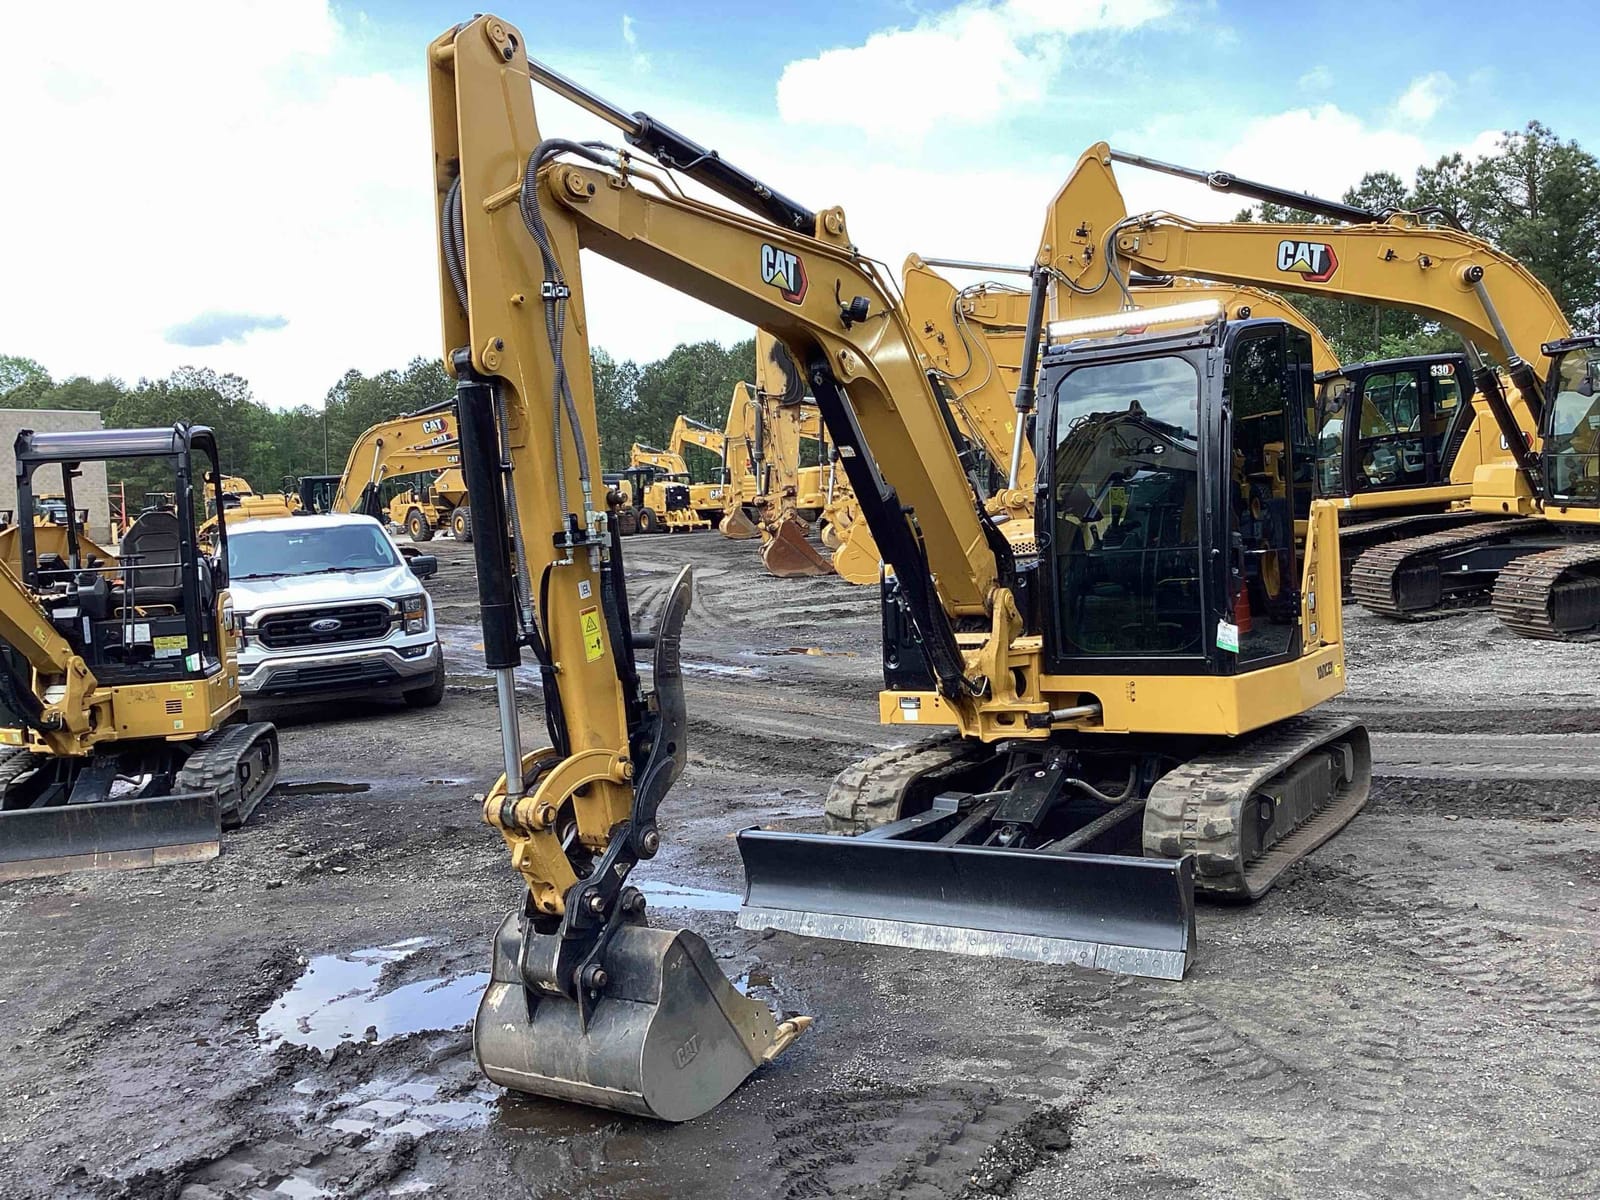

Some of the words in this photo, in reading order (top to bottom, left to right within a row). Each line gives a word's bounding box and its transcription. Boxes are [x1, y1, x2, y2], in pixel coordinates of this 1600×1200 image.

[761, 244, 797, 291] CAT
[1277, 240, 1325, 273] CAT
[1430, 364, 1449, 376] 330
[422, 418, 442, 434] CAT
[447, 455, 458, 463] CAT
[675, 1033, 699, 1069] CAT
